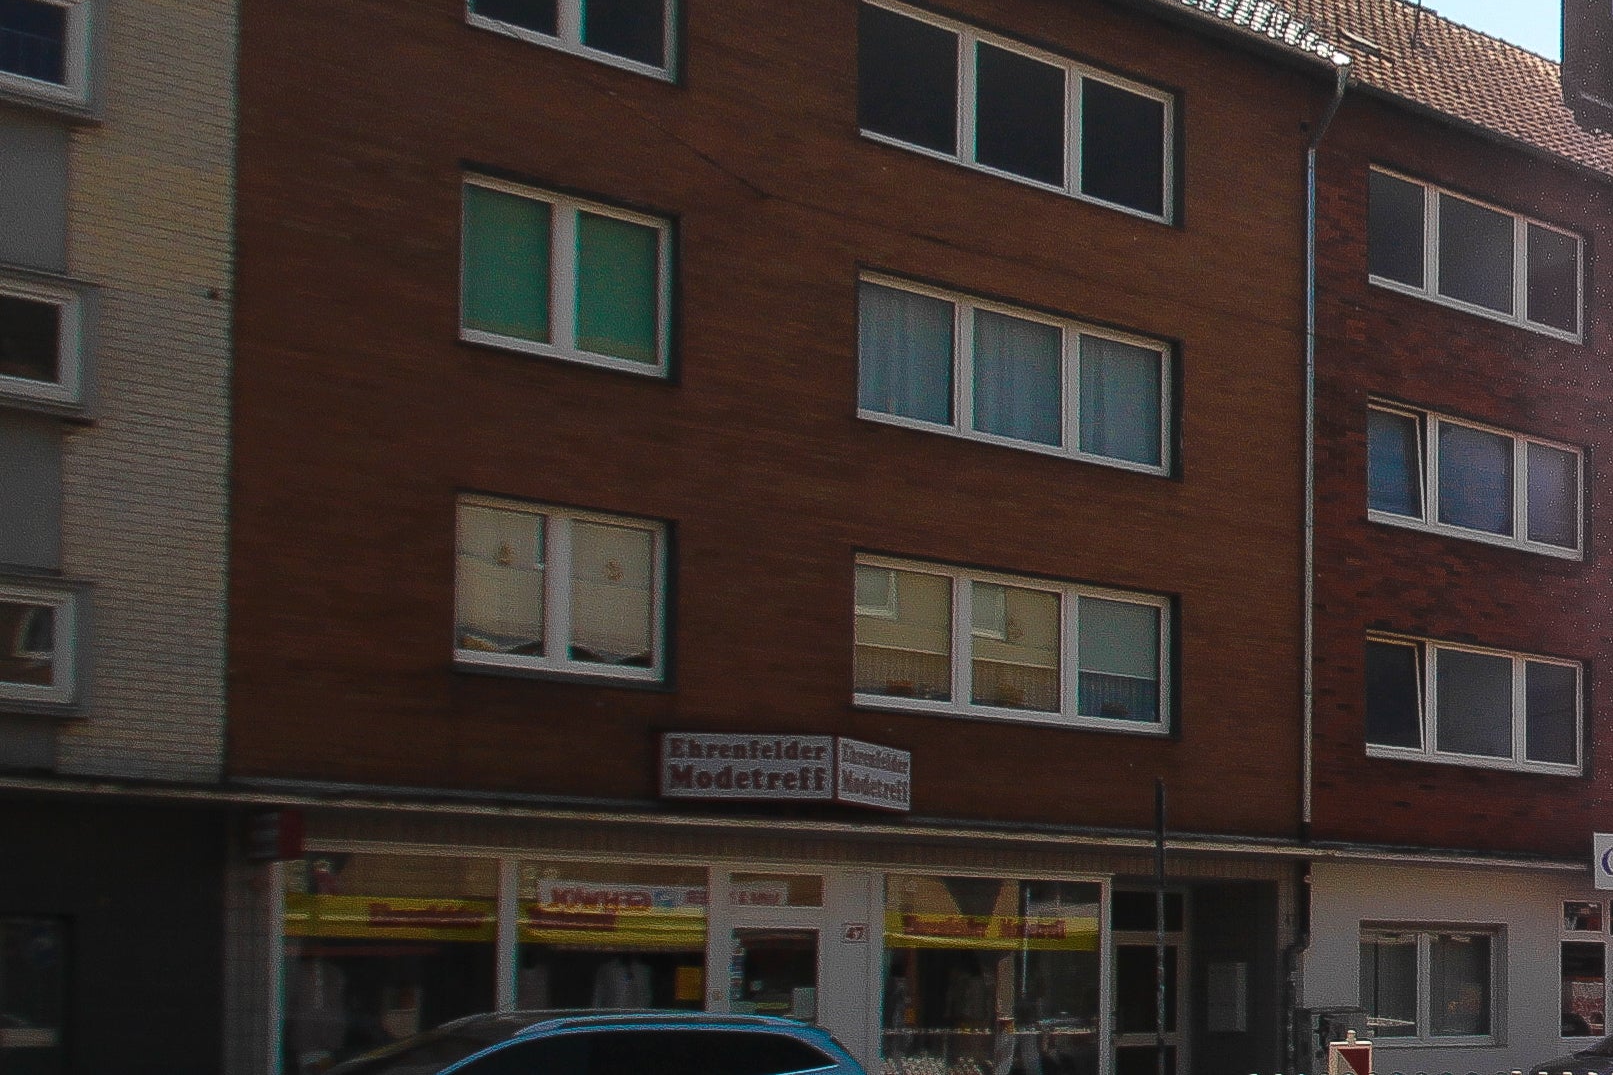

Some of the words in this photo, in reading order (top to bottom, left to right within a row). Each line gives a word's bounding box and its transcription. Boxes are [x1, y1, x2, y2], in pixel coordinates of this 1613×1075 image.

[669, 738, 827, 760] Ehrenfelder
[842, 743, 909, 774] Ehrenfelder
[670, 764, 827, 790] Modetreff
[842, 769, 909, 803] Modetreff
[846, 927, 864, 939] 47
